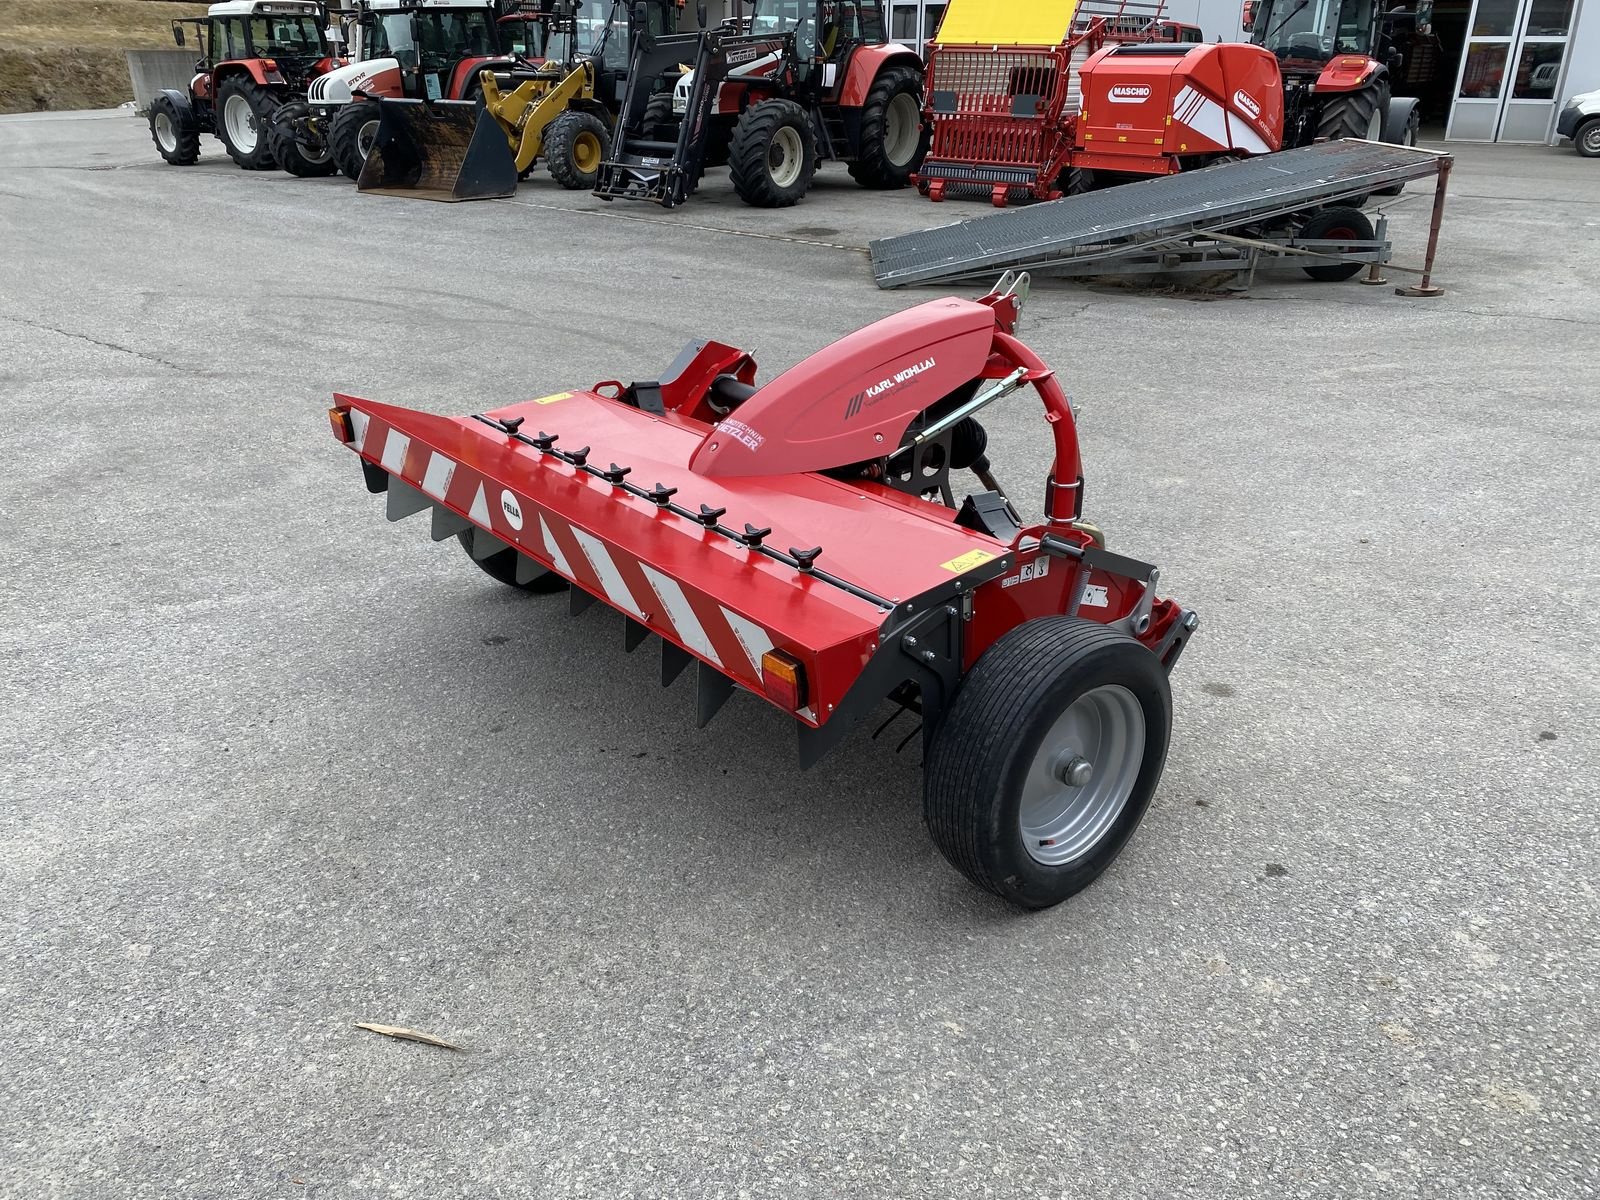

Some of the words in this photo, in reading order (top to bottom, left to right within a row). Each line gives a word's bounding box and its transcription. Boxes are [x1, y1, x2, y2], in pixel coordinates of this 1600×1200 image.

[731, 53, 756, 62] HYDRAC
[347, 72, 366, 87] STEYR
[1114, 87, 1150, 96] MASCHIO
[1238, 91, 1260, 115] MASCHIO
[866, 379, 895, 398] KARL
[503, 501, 521, 520] FELLA
